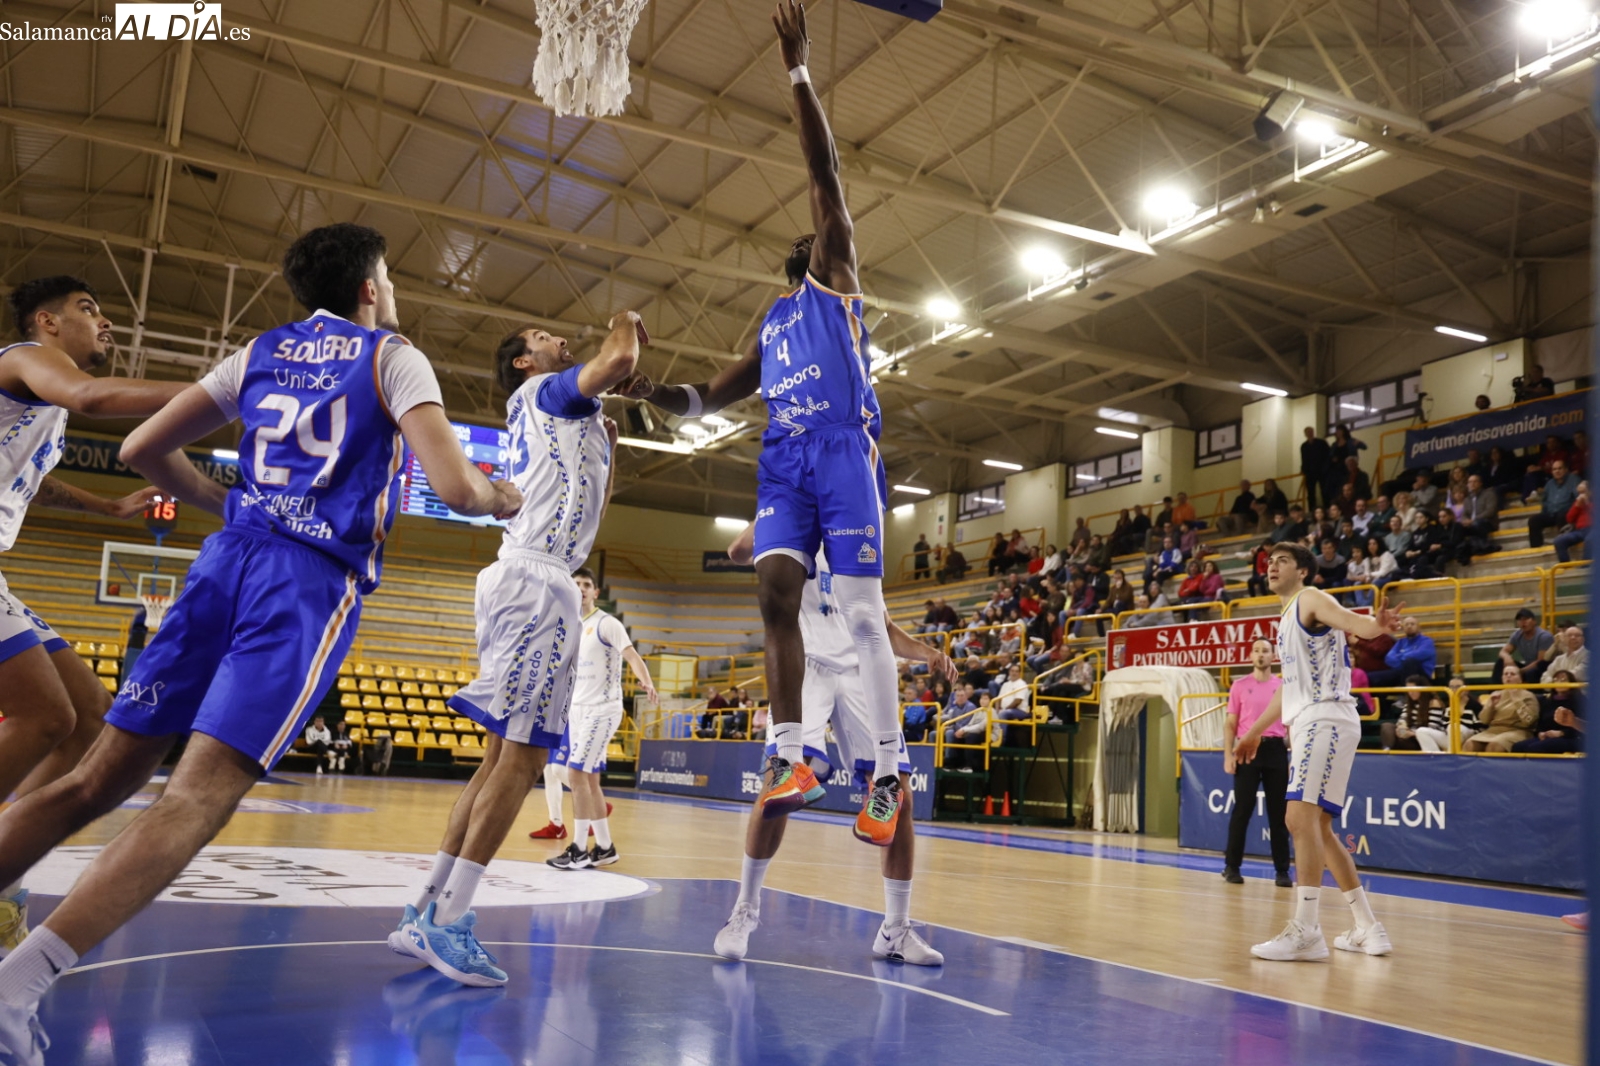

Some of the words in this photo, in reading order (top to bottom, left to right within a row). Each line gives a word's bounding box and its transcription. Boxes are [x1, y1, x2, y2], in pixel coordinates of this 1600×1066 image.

[272, 335, 363, 363] S.OLLERO
[776, 338, 791, 367] 4
[254, 393, 348, 488] 24
[1156, 620, 1279, 649] SALAMAN
[1132, 647, 1214, 666] PATRIMONIO
[1215, 645, 1238, 663] DE
[520, 650, 543, 714] culleredo
[1366, 788, 1446, 830] LEÓN
